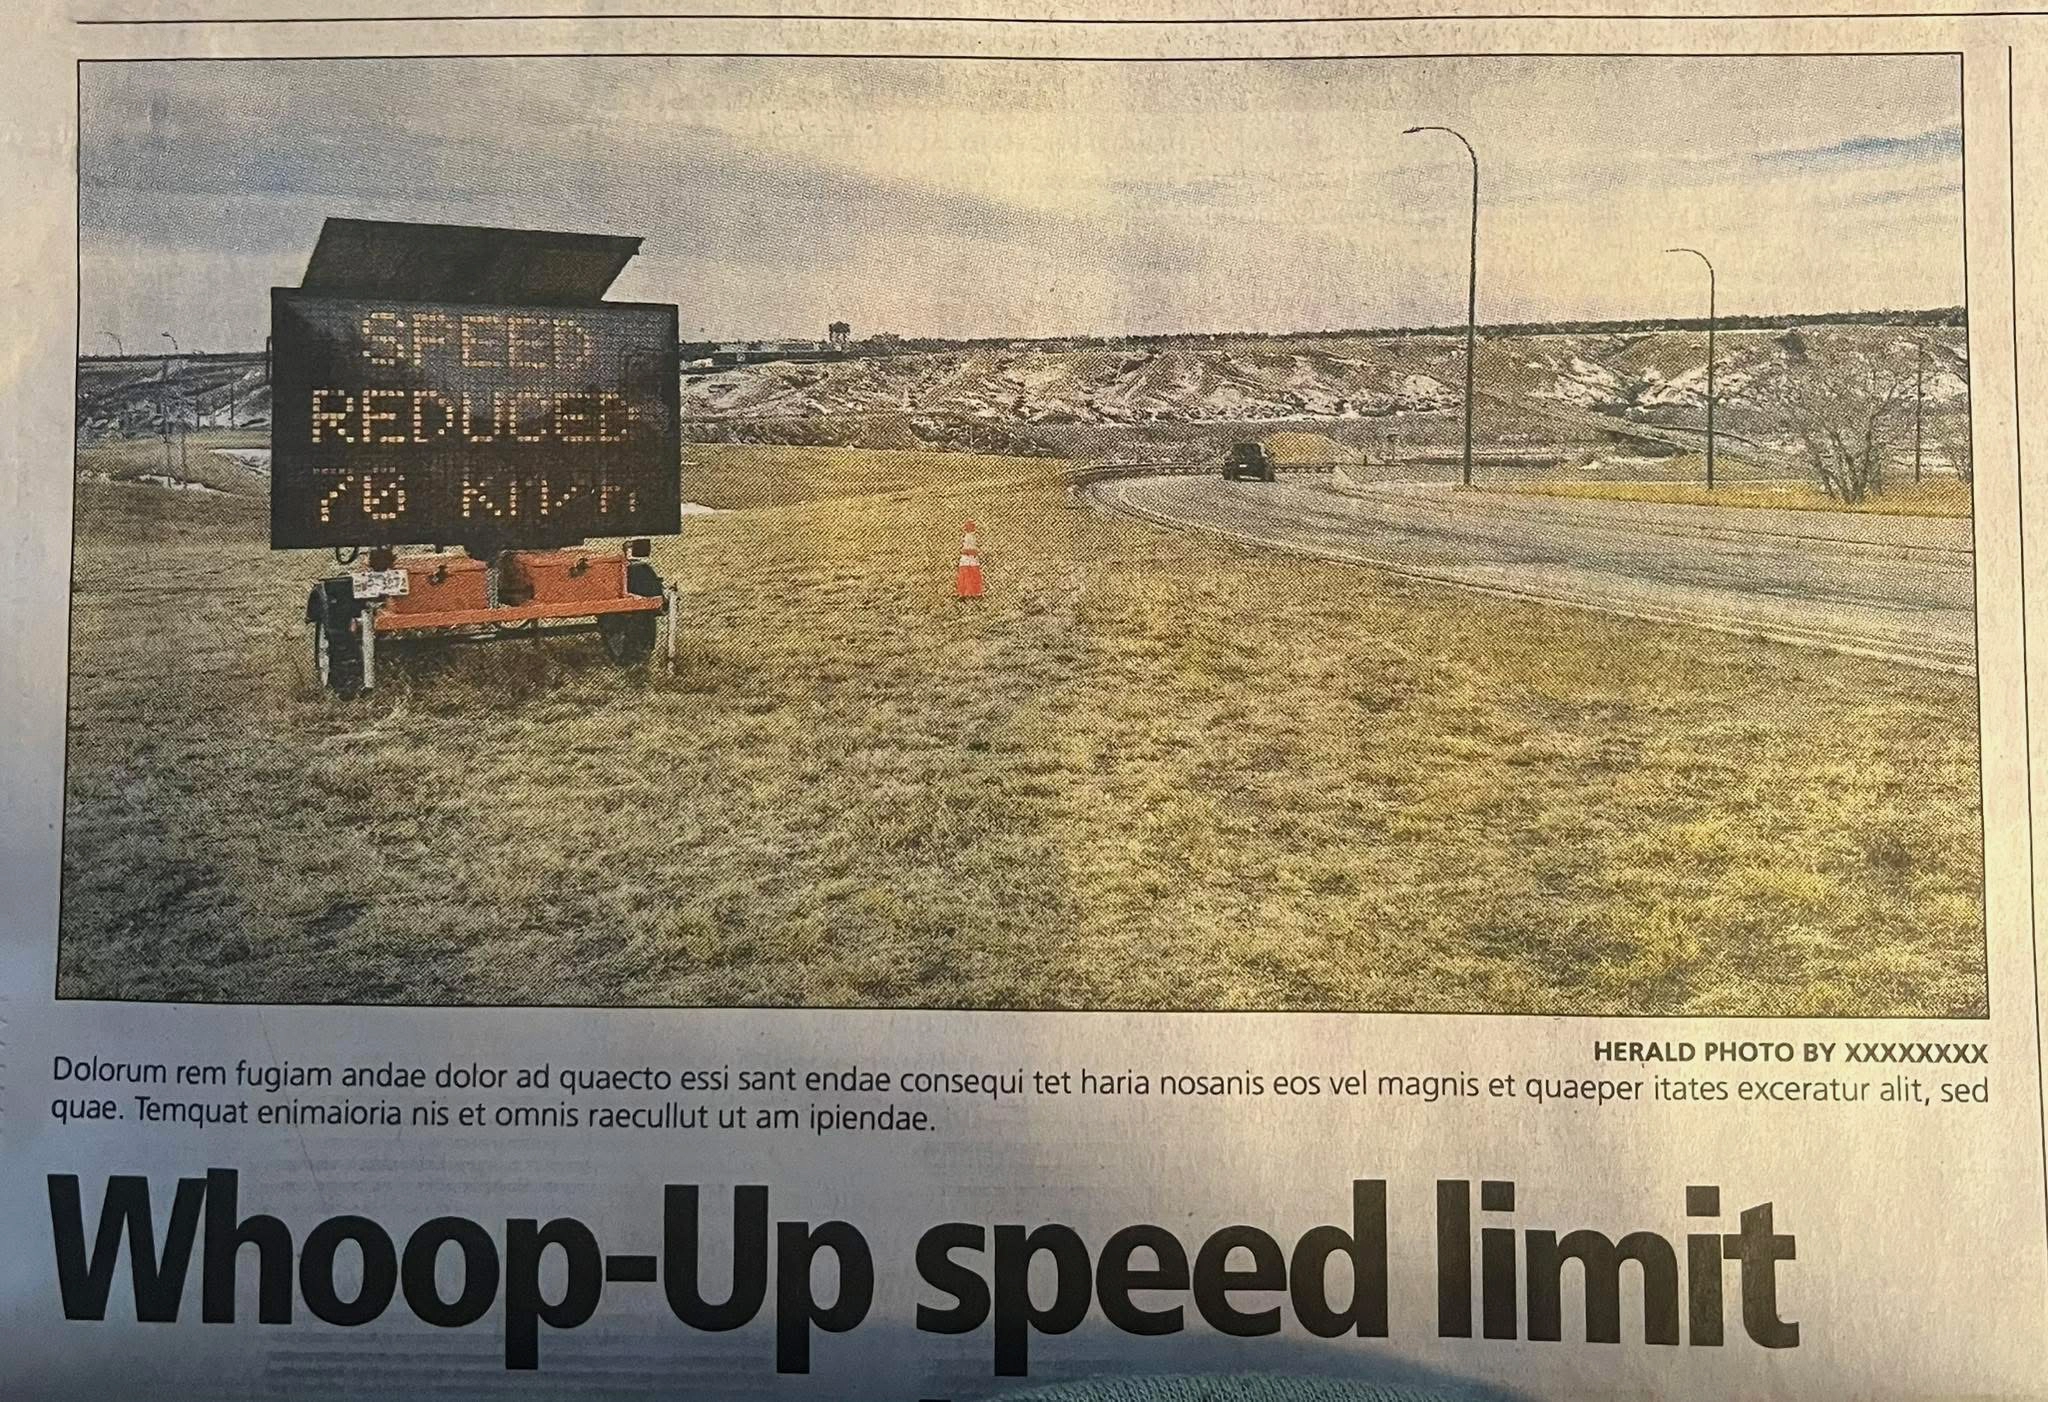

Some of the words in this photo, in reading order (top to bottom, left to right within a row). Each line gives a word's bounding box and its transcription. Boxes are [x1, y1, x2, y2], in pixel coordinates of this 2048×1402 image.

[362, 312, 594, 368] SPEED
[311, 389, 641, 443] REDUCED
[1594, 1041, 1696, 1063] HERALD
[1705, 1042, 1794, 1063] PHOTO
[1804, 1043, 1837, 1063] BY
[1845, 1042, 1989, 1064] XXXXXXXX
[54, 1056, 166, 1084] Dolorum
[177, 1066, 226, 1085] rem
[236, 1060, 331, 1093] fugiam
[342, 1062, 426, 1088] andae
[436, 1062, 507, 1088] dolor
[517, 1063, 549, 1089] ad
[560, 1067, 671, 1097] quaecto
[681, 1065, 728, 1090] essi
[739, 1068, 796, 1091] sant
[806, 1065, 890, 1092] endae
[901, 1067, 1022, 1100] consequi
[1033, 1070, 1071, 1094] tet
[1082, 1068, 1149, 1095] haria
[1161, 1070, 1264, 1096] nosanis
[1274, 1075, 1320, 1096] eos
[1330, 1070, 1366, 1096] vel
[1379, 1071, 1479, 1103] magnis
[1489, 1074, 1516, 1097] et
[1526, 1078, 1643, 1107] quaeper
[1655, 1075, 1728, 1100] itates
[1738, 1078, 1869, 1102] exceratur
[1881, 1075, 1930, 1107] alit,
[1941, 1076, 1988, 1102] sed
[51, 1098, 124, 1127] quae.
[135, 1096, 248, 1129] Temquat
[258, 1098, 401, 1126] enimaioria
[413, 1100, 448, 1126] nis
[459, 1104, 486, 1126] et
[496, 1101, 578, 1128] omnis
[590, 1102, 708, 1128] raecullut
[719, 1105, 746, 1128] ut
[757, 1109, 798, 1128] am
[811, 1103, 935, 1136] ipiendae.
[47, 1168, 874, 1373] Whoop-Up
[915, 1180, 1389, 1377] speed
[1436, 1180, 1800, 1349] limit
